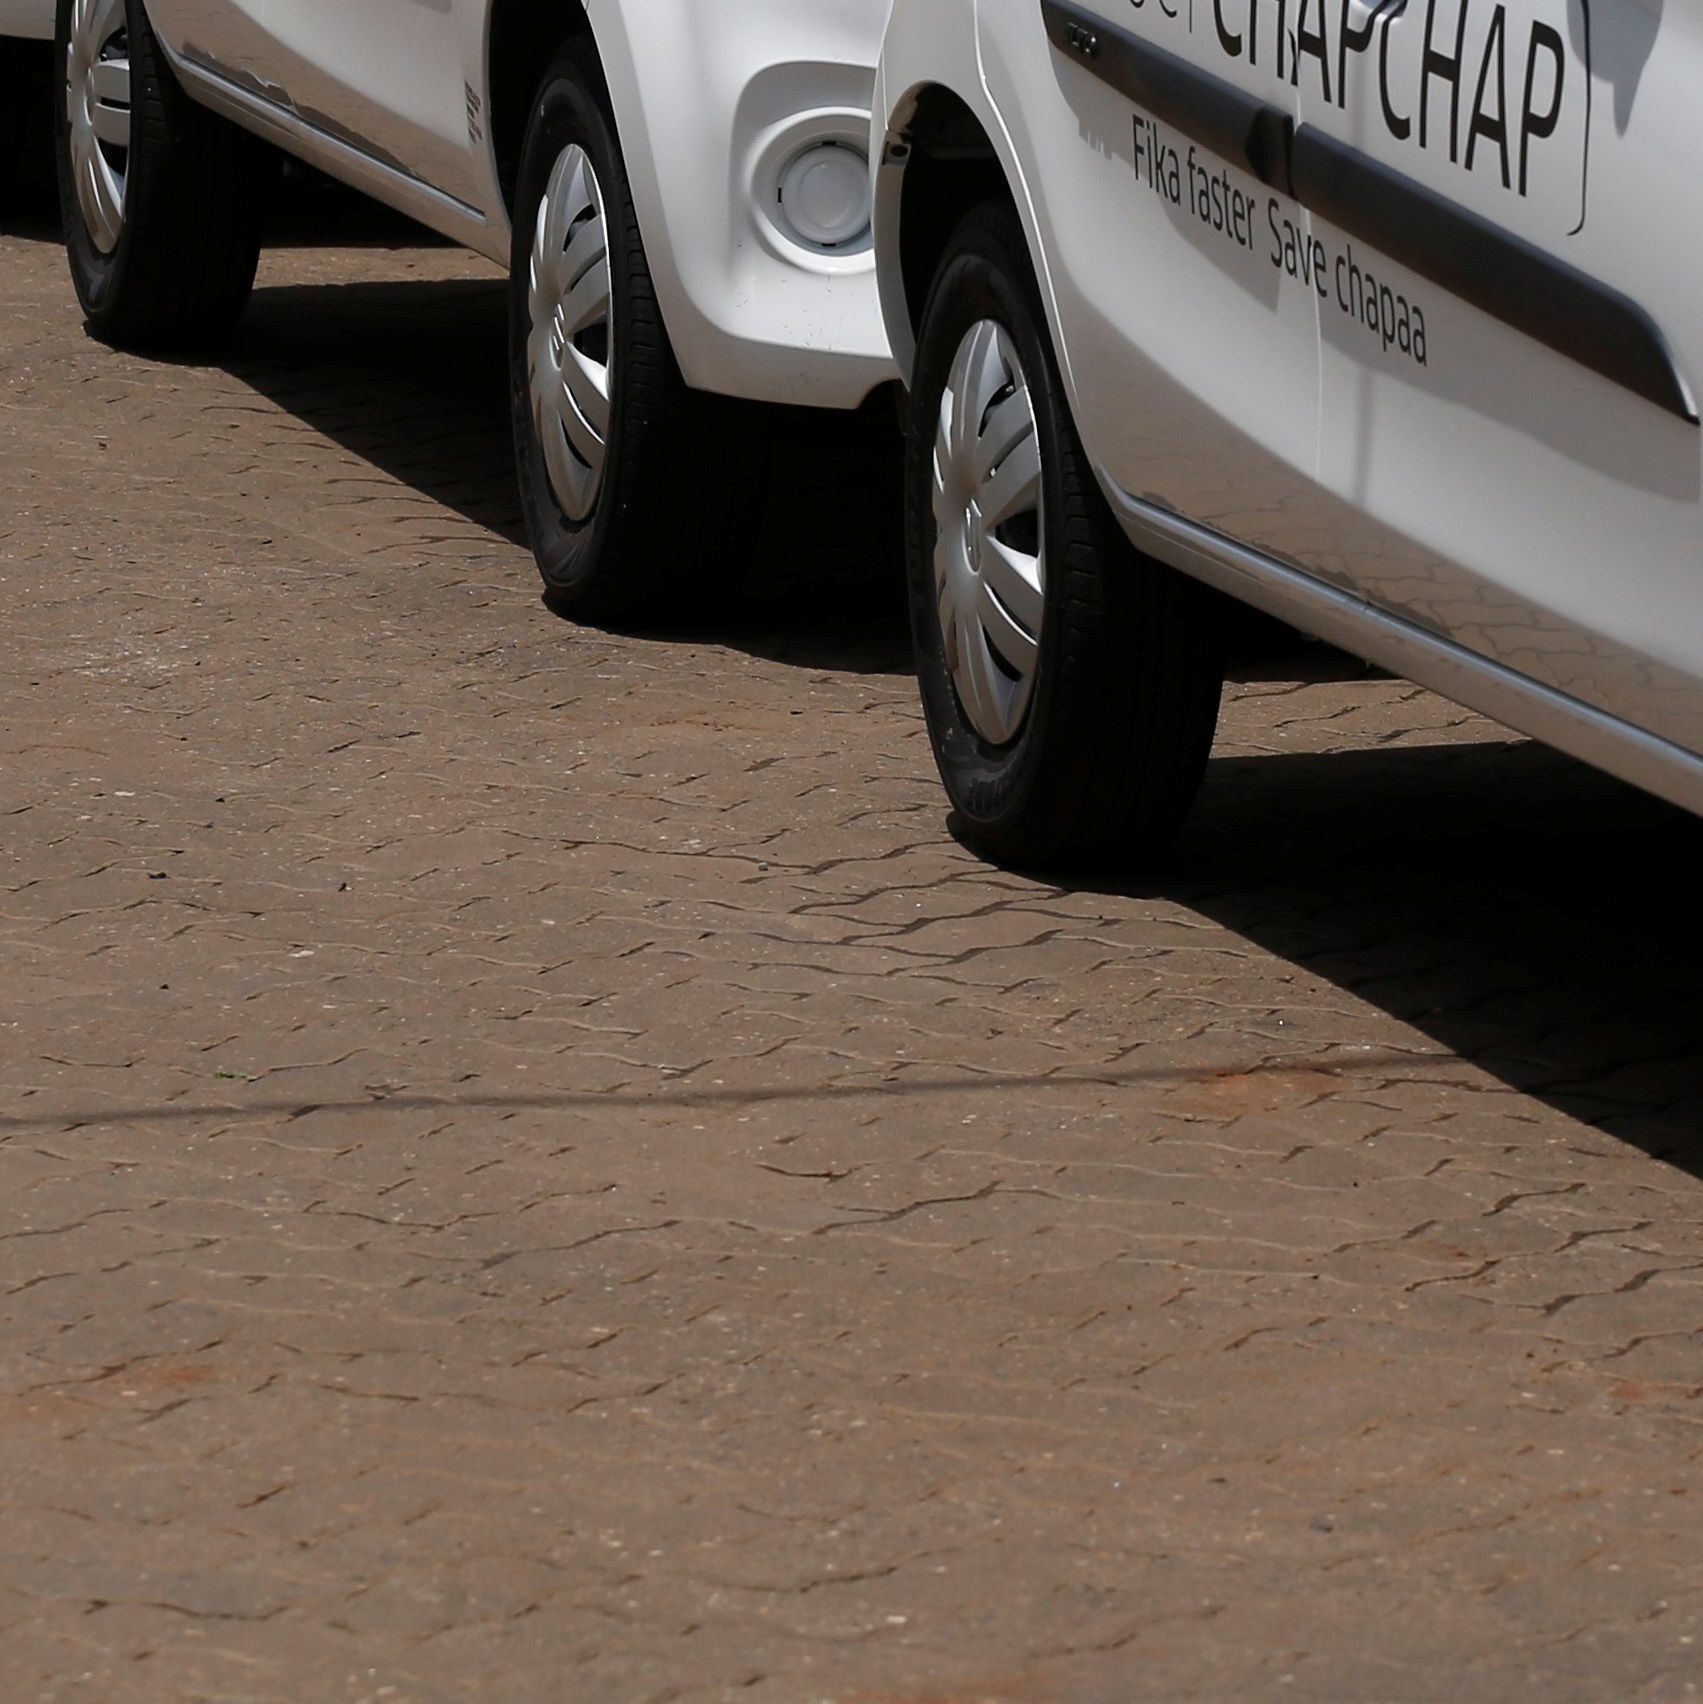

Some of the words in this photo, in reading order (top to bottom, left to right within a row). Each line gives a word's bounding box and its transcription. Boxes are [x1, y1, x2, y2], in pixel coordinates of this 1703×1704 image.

[1131, 113, 1181, 207] Fika
[1187, 145, 1256, 251] faster
[1267, 196, 1328, 299] Save
[1334, 243, 1428, 368] chapaa
